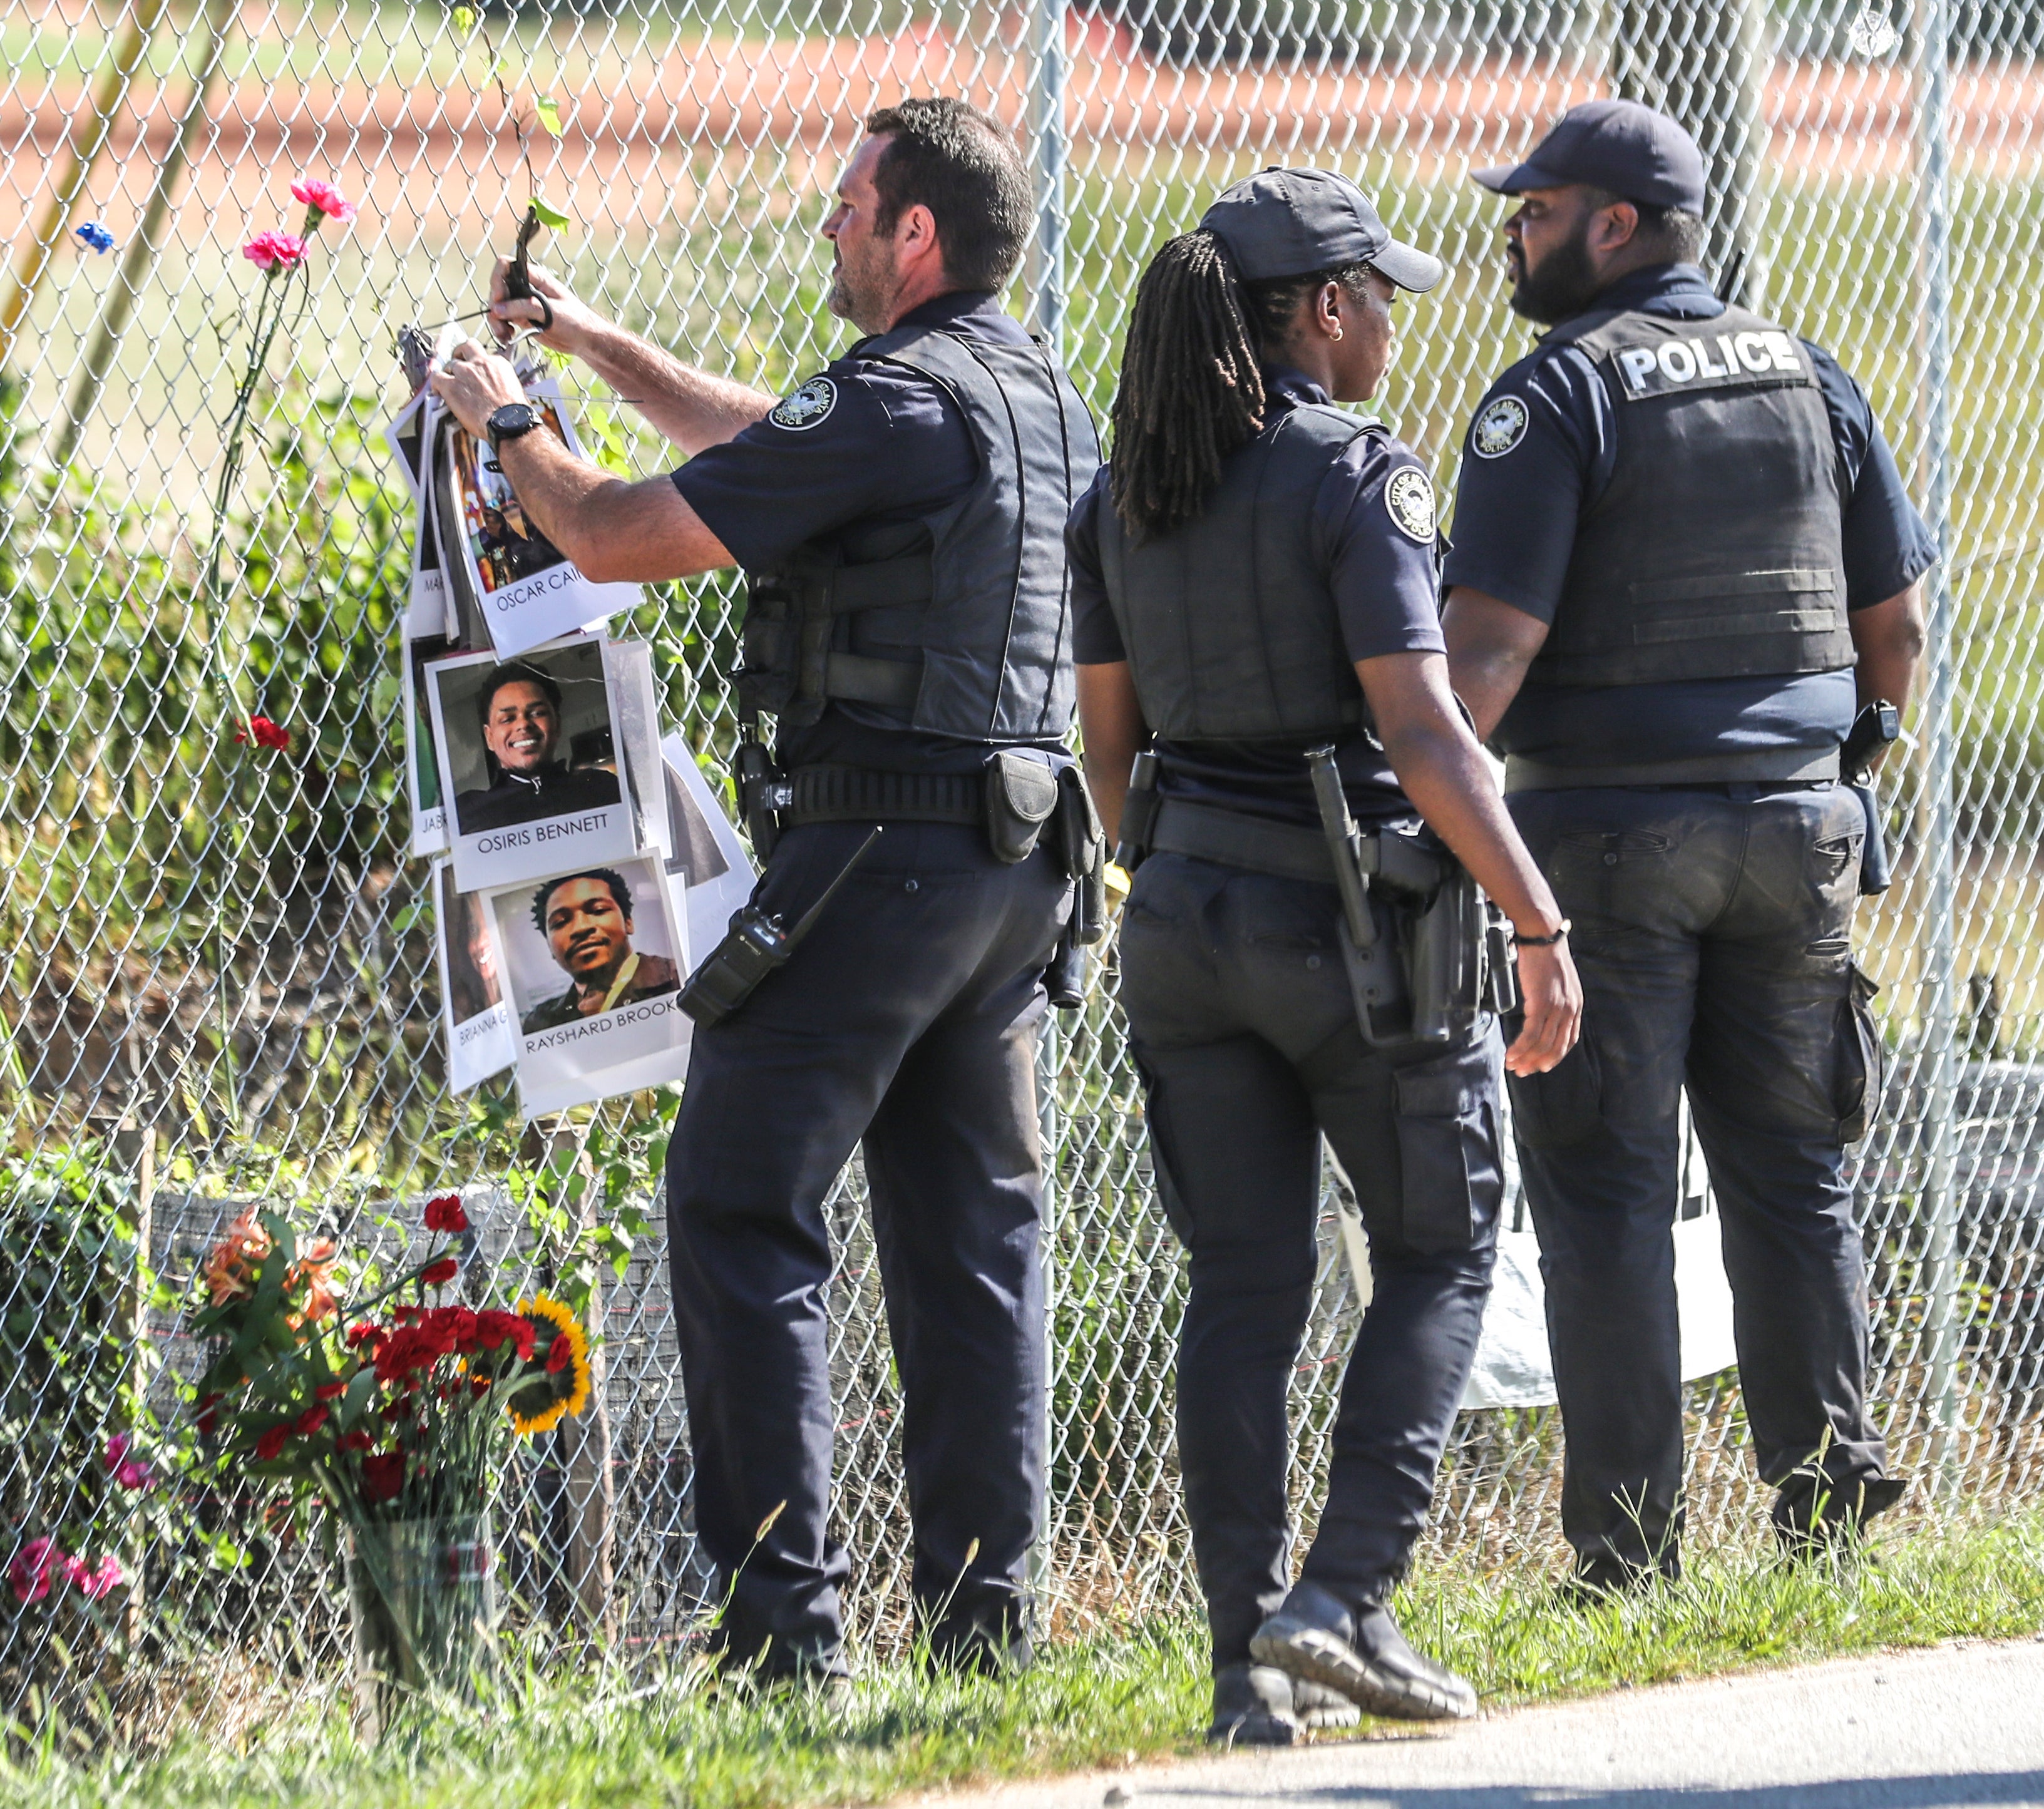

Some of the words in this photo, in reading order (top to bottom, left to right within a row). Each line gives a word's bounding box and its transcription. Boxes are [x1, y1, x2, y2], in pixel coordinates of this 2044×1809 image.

[1620, 331, 1800, 391] POLICE
[1481, 439, 1514, 453] POLICE
[1390, 481, 1402, 506] CITY
[1397, 473, 1410, 486] OF
[496, 580, 547, 612] OSCAR
[478, 829, 531, 854] OSIRIS
[535, 814, 608, 842] BENNETT
[525, 1018, 612, 1054] RAYSHARD
[616, 998, 677, 1027] BROOK
